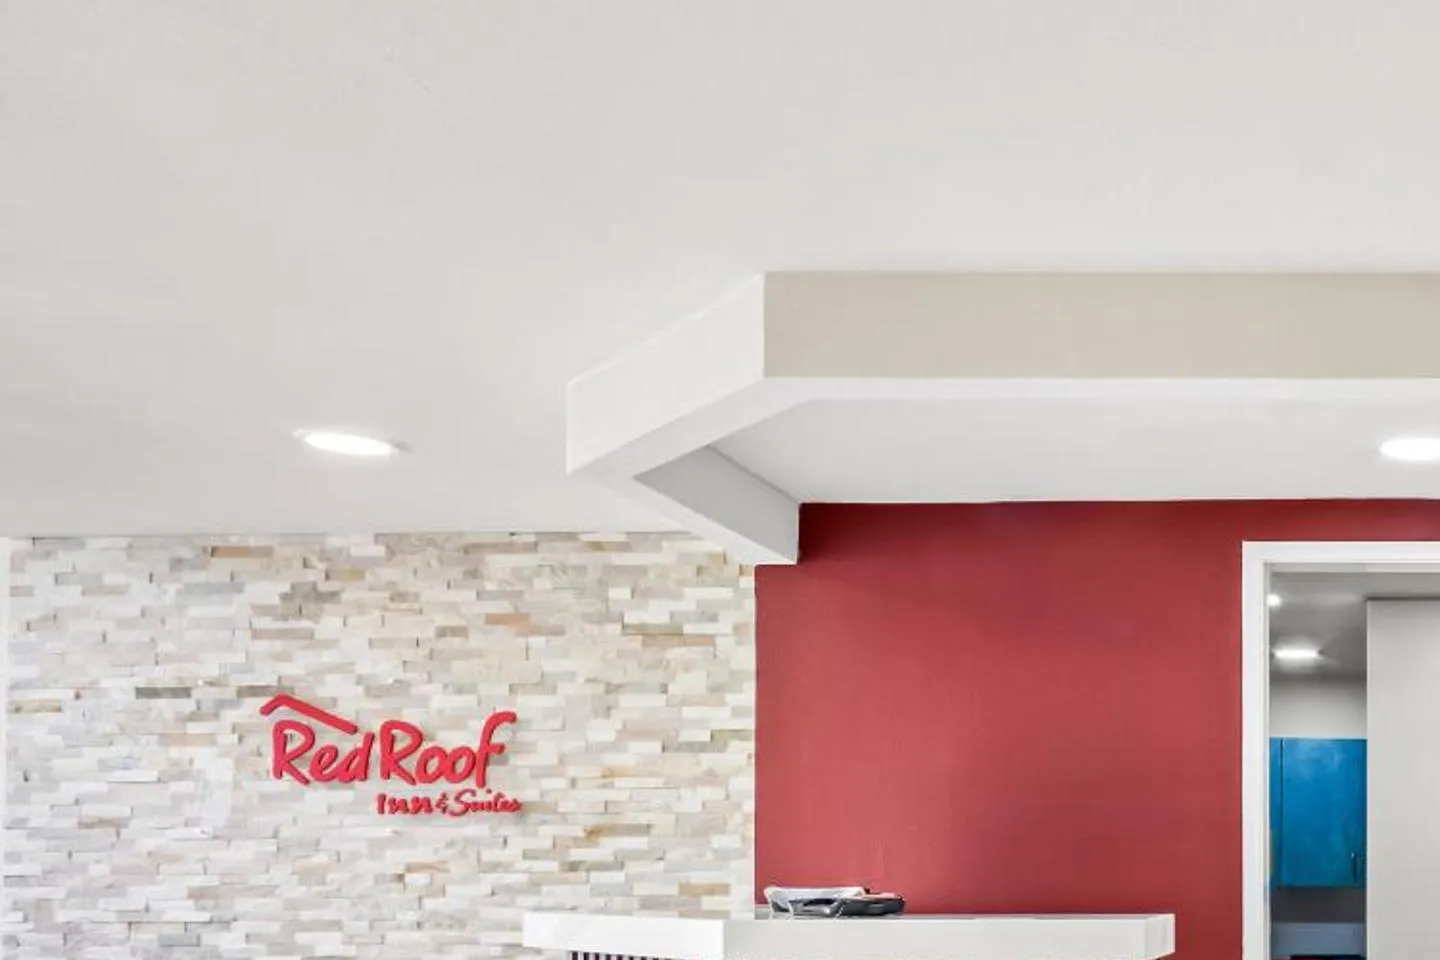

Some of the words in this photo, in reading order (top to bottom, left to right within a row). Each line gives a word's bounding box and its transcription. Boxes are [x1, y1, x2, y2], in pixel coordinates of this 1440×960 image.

[272, 719, 375, 785] Red
[379, 711, 517, 788] Roof
[376, 793, 432, 815] Inn
[451, 788, 522, 816] Suites
